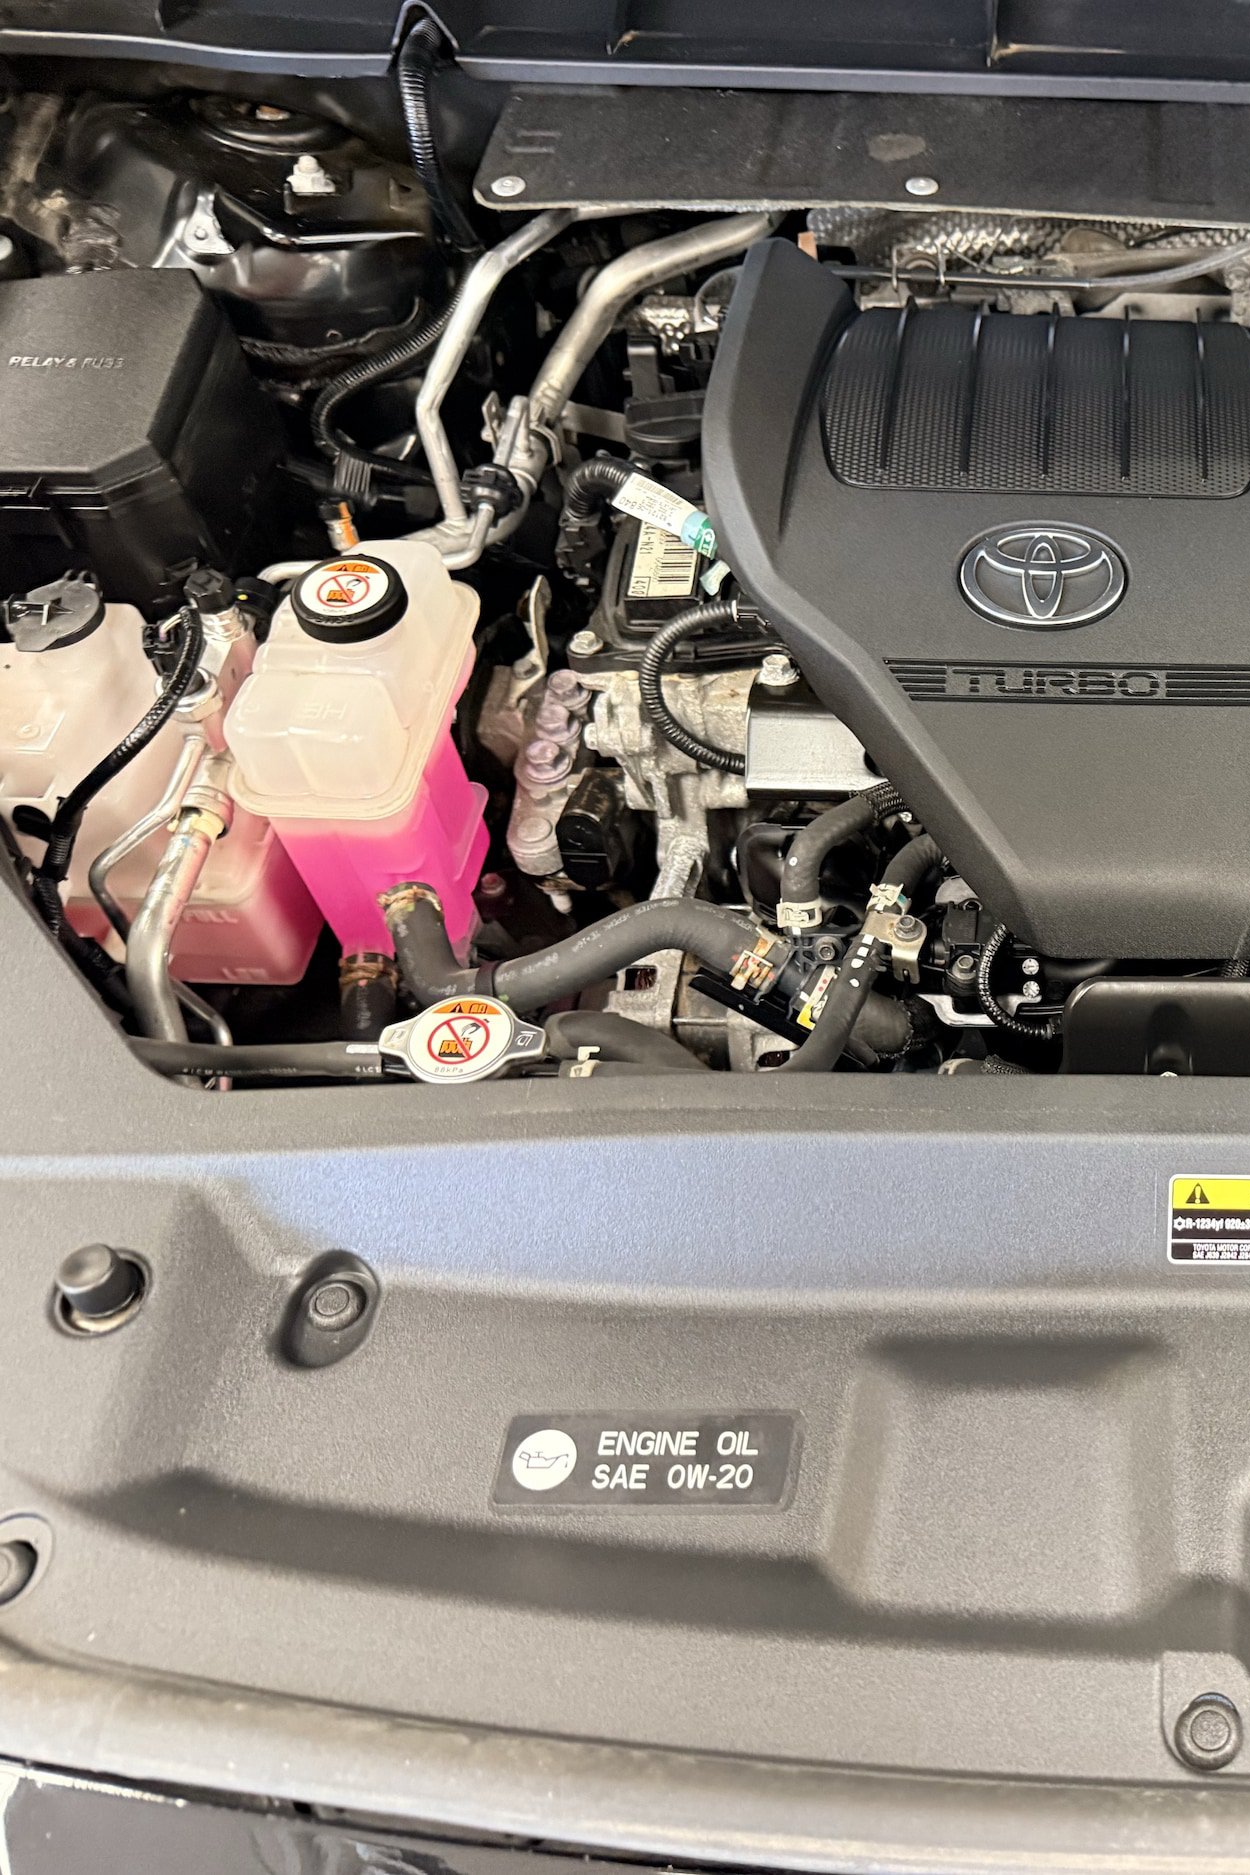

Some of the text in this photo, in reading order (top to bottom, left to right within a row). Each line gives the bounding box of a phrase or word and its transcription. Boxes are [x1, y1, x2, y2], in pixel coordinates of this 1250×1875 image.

[9, 356, 65, 367] RELAY
[952, 667, 1161, 696] TURBO
[1193, 1243, 1216, 1251] TOYOTA
[1216, 1244, 1238, 1252] MOTOR
[597, 1431, 758, 1456] ENGINE OIL
[591, 1464, 753, 1490] SAE 0W-20
